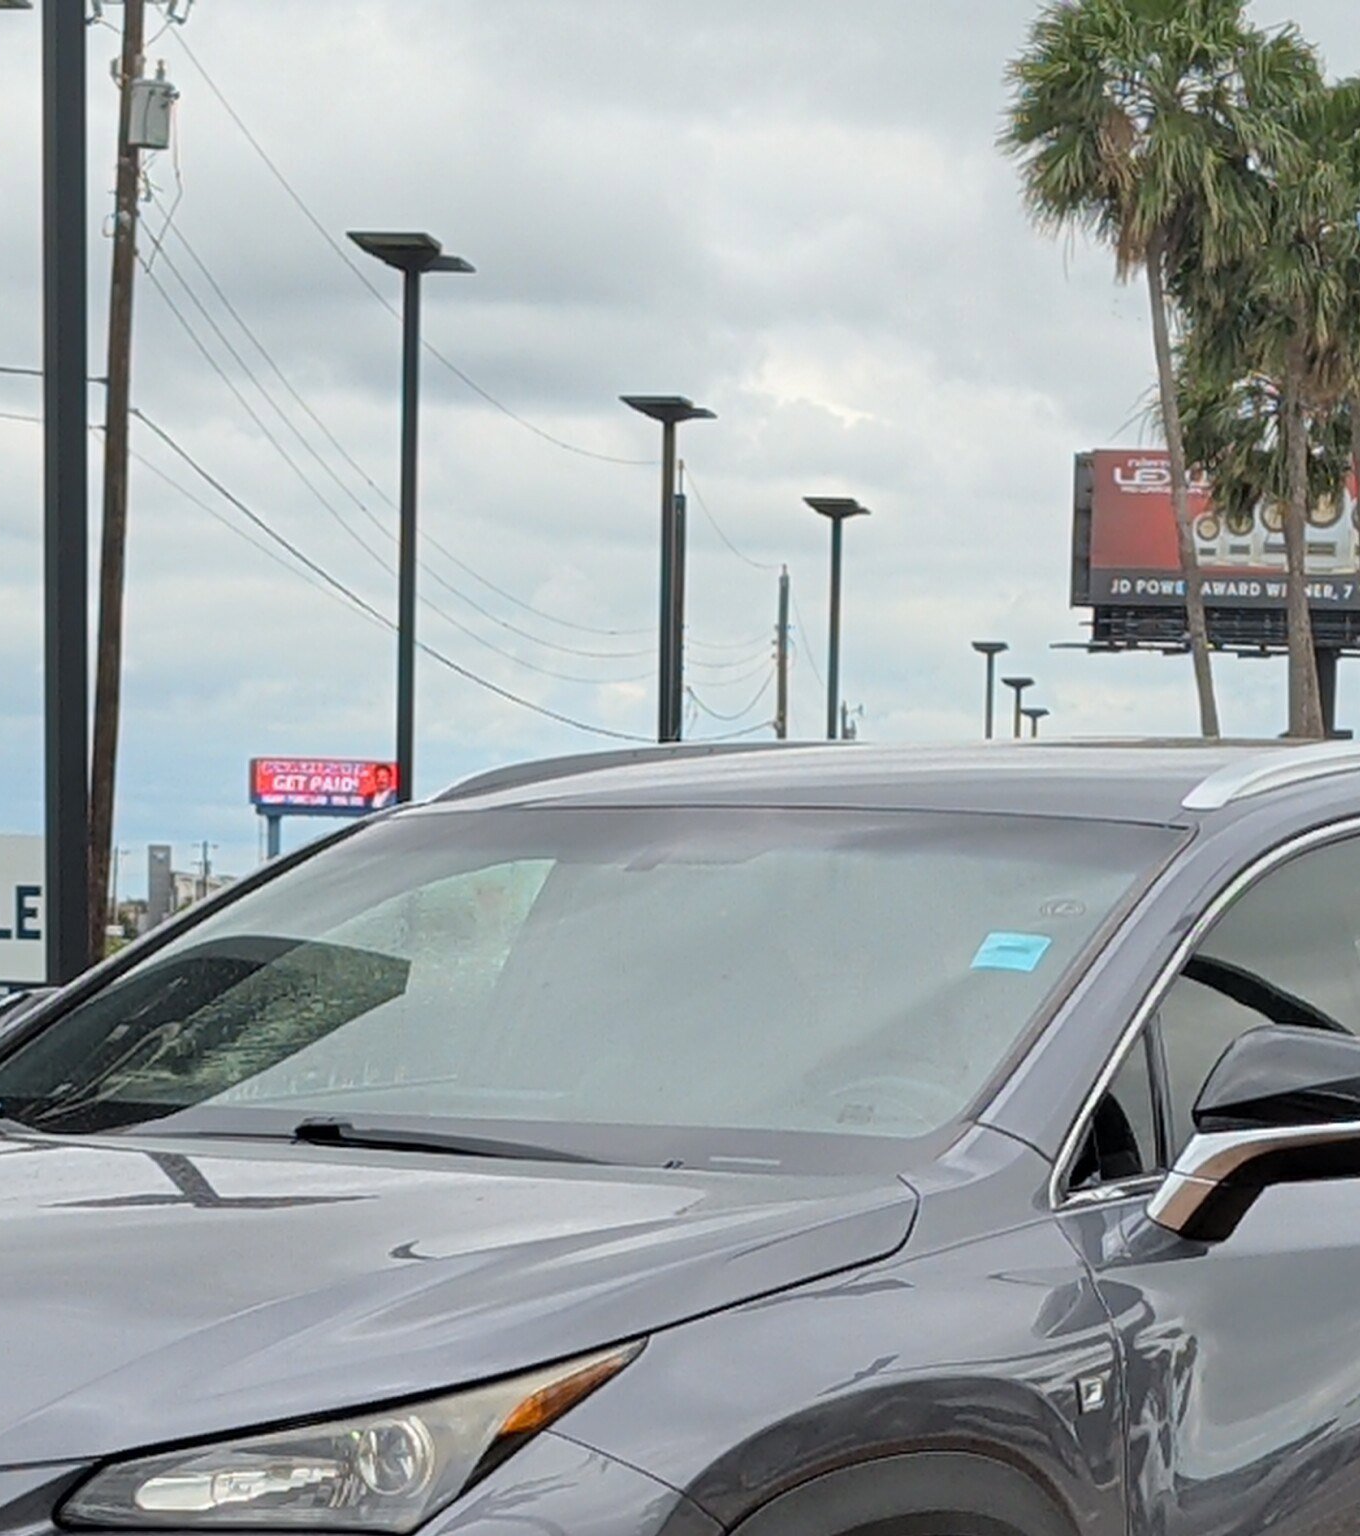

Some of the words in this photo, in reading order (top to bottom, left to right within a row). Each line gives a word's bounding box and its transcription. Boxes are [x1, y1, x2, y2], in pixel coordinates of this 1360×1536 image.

[1110, 579, 1131, 595] JD
[1135, 579, 1187, 596] POWE
[1200, 580, 1261, 597] AWARD
[1266, 582, 1339, 600] WINER,
[1343, 583, 1354, 599] 7
[272, 774, 308, 791] GET
